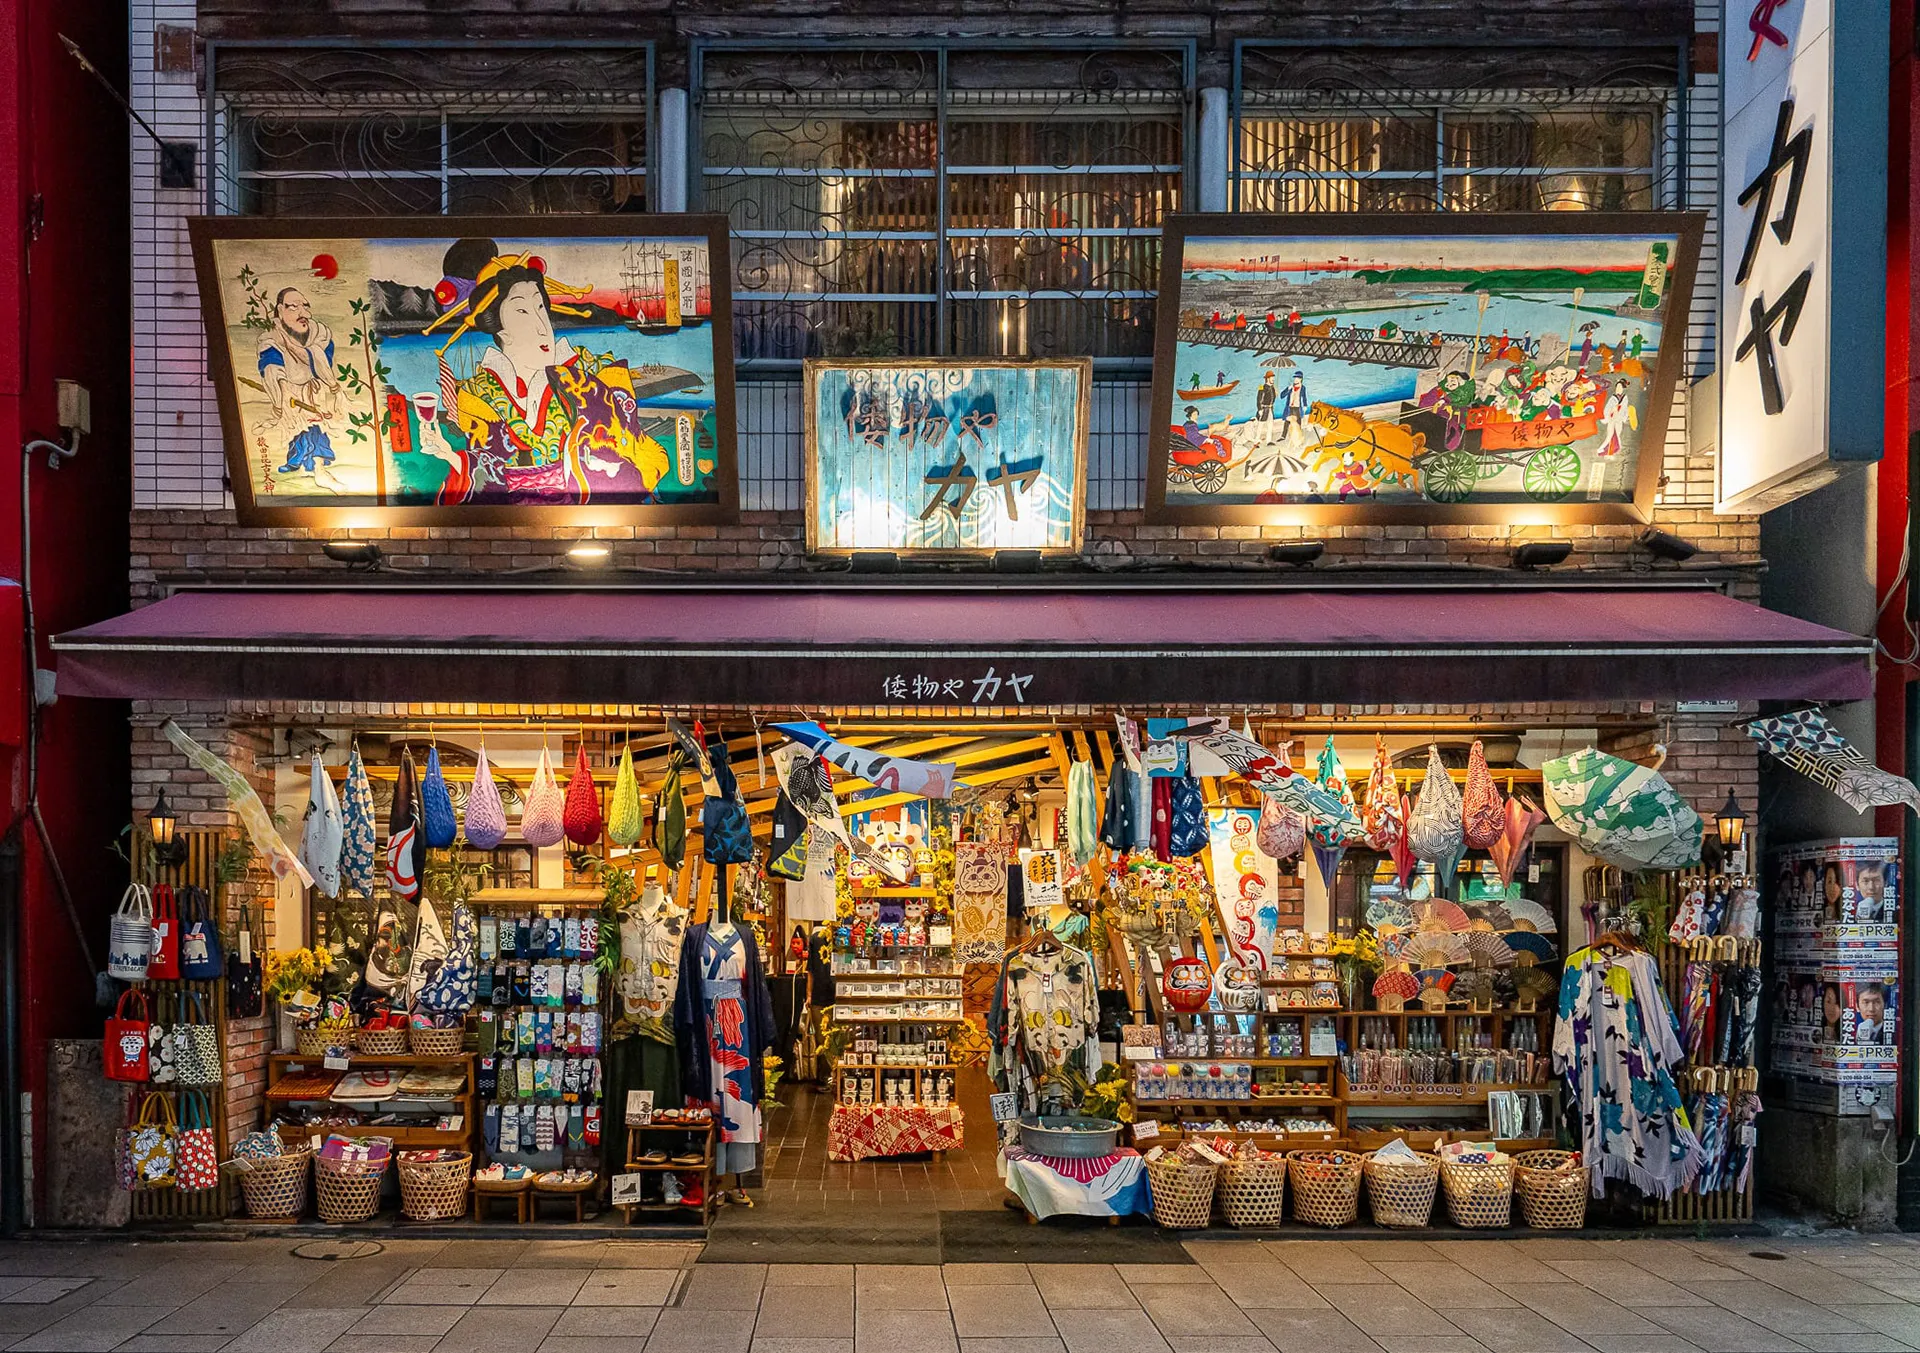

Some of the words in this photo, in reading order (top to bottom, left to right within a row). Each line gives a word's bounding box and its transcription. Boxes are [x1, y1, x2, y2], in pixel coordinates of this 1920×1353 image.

[1735, 98, 1813, 416] カヤ
[844, 398, 999, 451] 倭物や
[1512, 420, 1575, 443] 倭物や
[919, 452, 1043, 522] カヤ
[882, 674, 964, 700] 倭物や
[972, 666, 1034, 703] カヤ
[1040, 851, 1058, 883] 衣料
[1842, 887, 1855, 924] あなた
[1842, 1008, 1855, 1045] あなた
